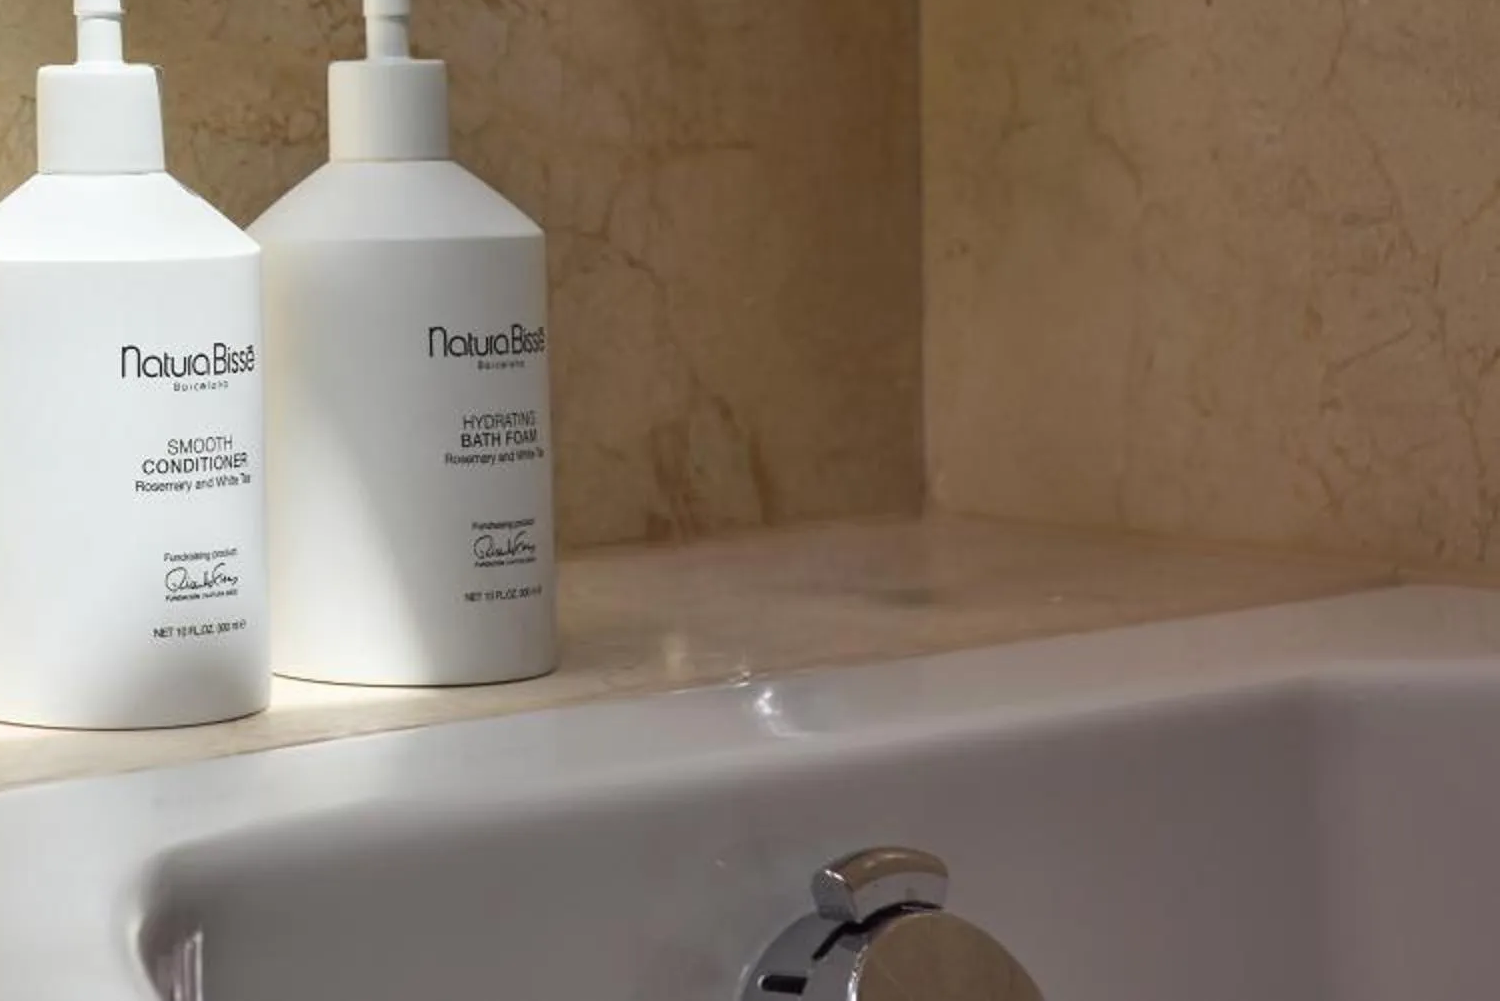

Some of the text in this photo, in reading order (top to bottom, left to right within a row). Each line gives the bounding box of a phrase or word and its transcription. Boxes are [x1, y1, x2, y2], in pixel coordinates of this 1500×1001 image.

[463, 410, 536, 430] HYDRATING
[167, 435, 233, 456] SMOOTH
[461, 428, 537, 448] BATH FOAM
[142, 451, 248, 475] CONDITIONER
[135, 480, 192, 493] Rosemary
[195, 478, 214, 490] and
